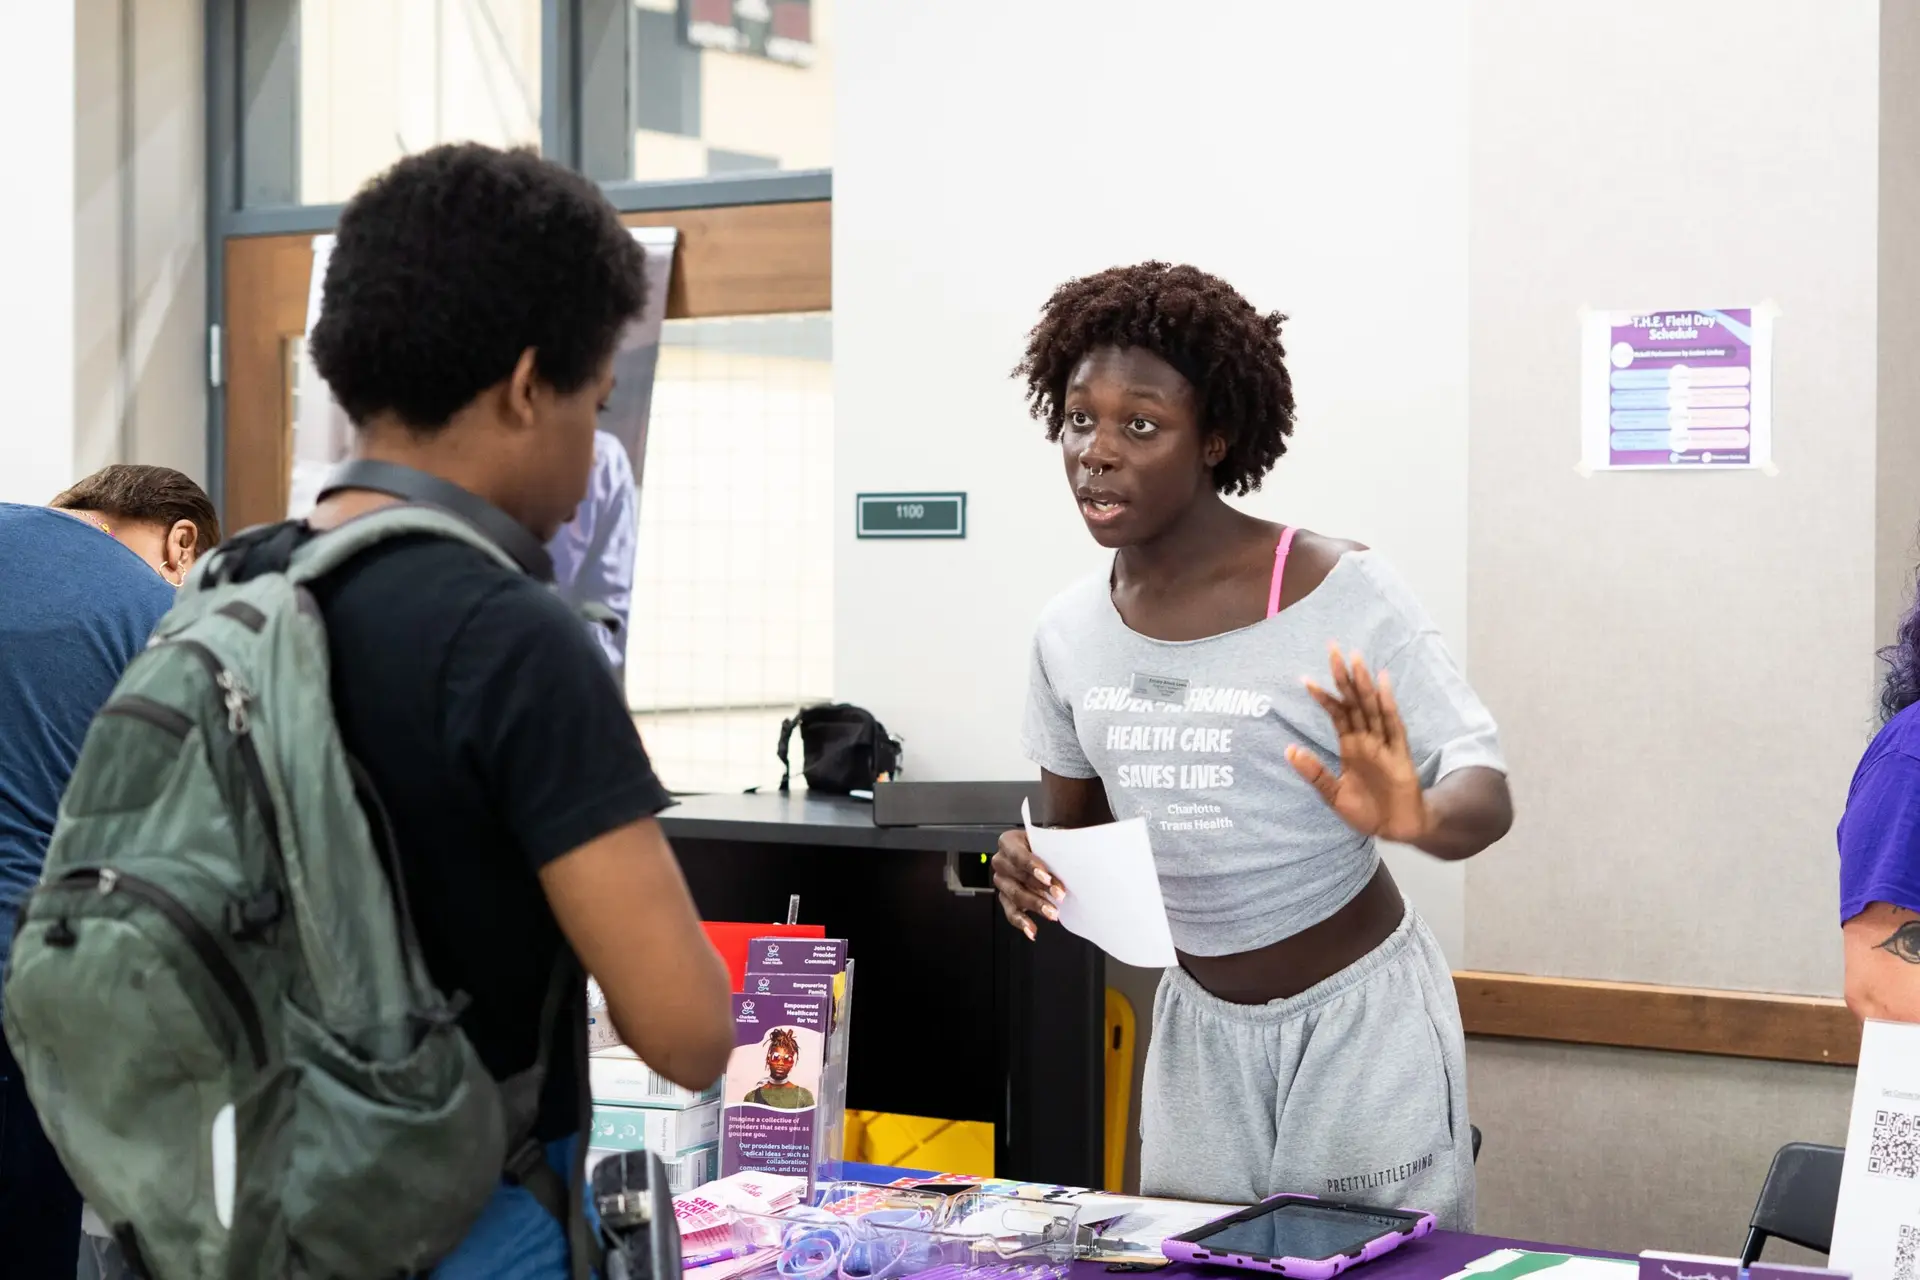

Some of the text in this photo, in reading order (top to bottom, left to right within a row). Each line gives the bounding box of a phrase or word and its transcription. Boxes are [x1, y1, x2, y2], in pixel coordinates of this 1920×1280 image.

[1665, 314, 1692, 327] Field
[1694, 314, 1716, 328] Day
[1649, 327, 1698, 340] Schedule
[896, 504, 924, 519] 1100
[1106, 725, 1233, 753] HEALTH CARE
[1117, 764, 1234, 790] SAVES LIVES
[1167, 803, 1221, 814] Charlotte
[1160, 816, 1233, 831] Trans Health
[804, 958, 836, 966] Community
[792, 982, 827, 990] Empowering
[784, 1002, 819, 1010] Empowered
[1327, 1153, 1433, 1192] PRETTYLITTLETHING
[691, 1197, 718, 1211] SAFE
